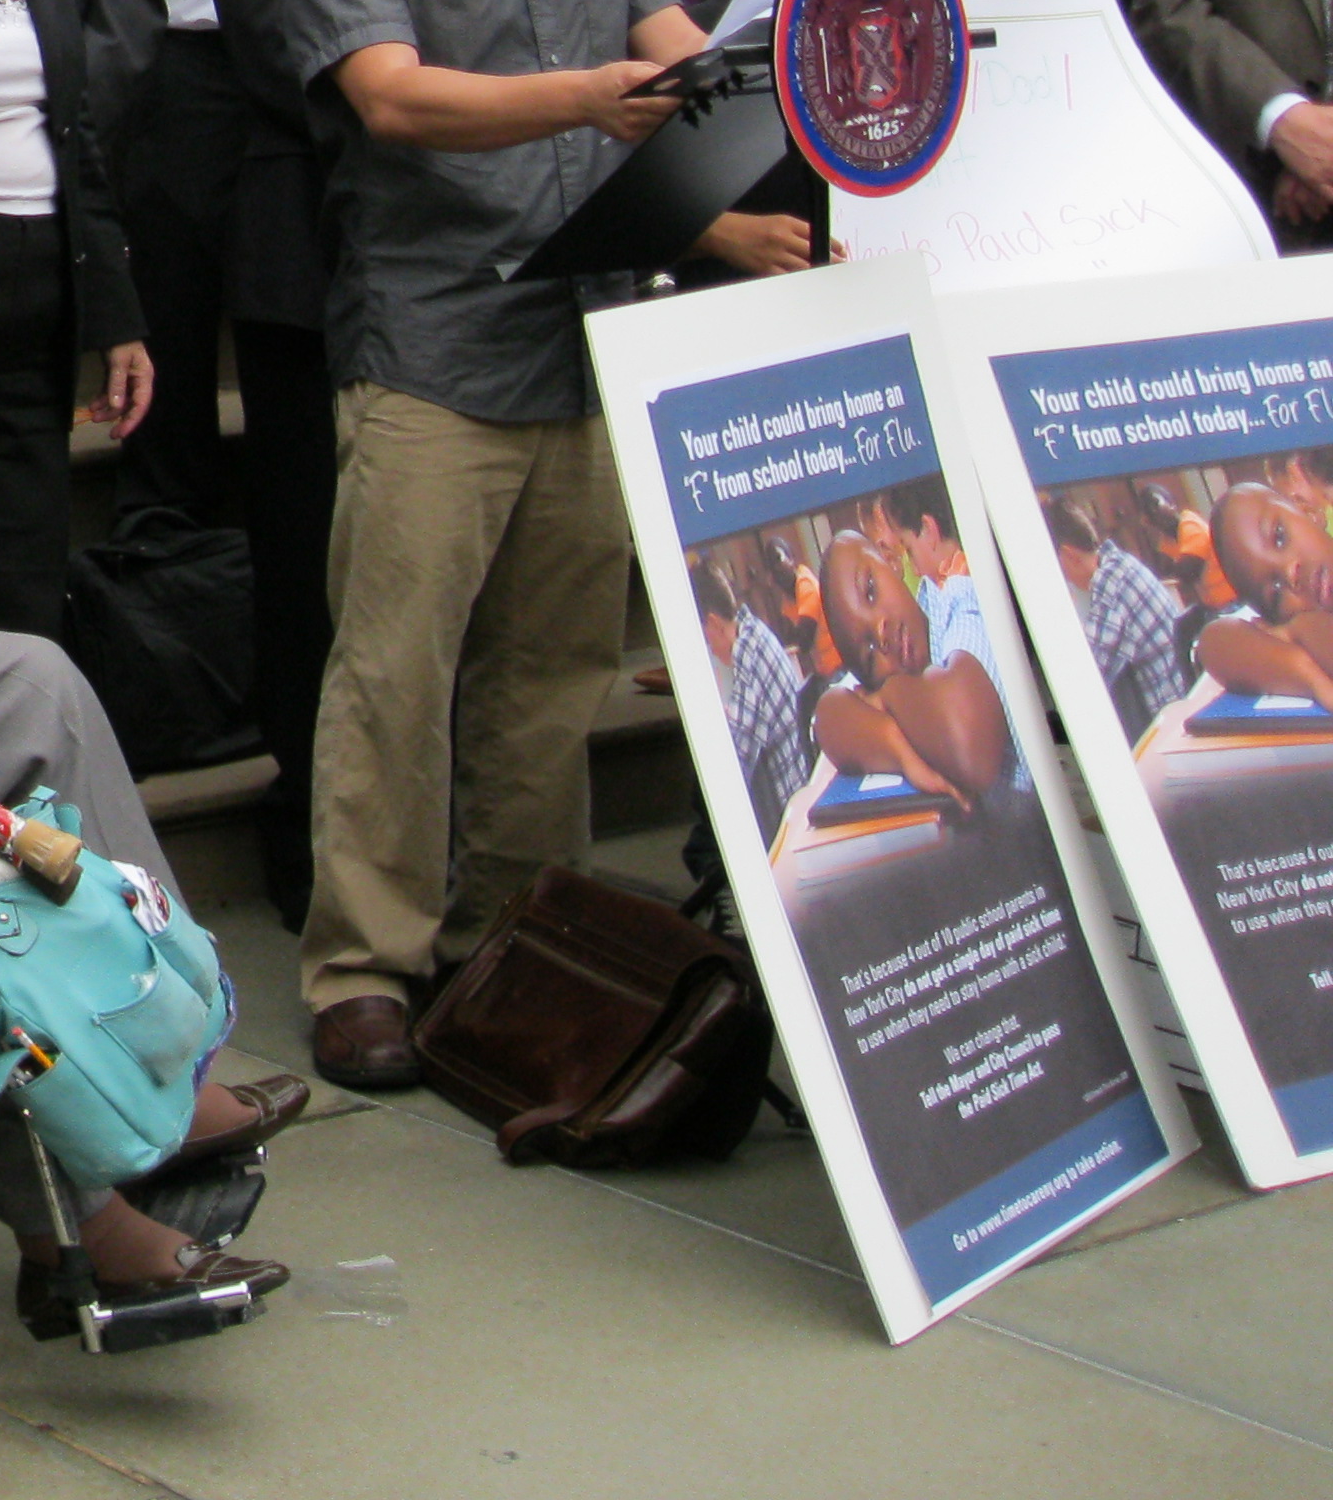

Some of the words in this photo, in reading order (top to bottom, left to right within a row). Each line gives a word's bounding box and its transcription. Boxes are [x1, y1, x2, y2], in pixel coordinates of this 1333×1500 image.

[946, 209, 1054, 265] Paid
[1059, 198, 1181, 249] Sick
[1031, 387, 1082, 415] Your
[1085, 377, 1131, 409] child
[1139, 371, 1195, 403] could
[1200, 362, 1250, 398] bring
[1250, 355, 1304, 386] home
[1309, 357, 1332, 378] an
[681, 426, 720, 462] Your
[722, 414, 760, 452] child
[762, 406, 805, 444] could
[806, 395, 843, 436] bring
[845, 390, 883, 421] home
[884, 383, 904, 408] an
[1072, 423, 1122, 452] from
[1125, 414, 1192, 445] school
[1192, 404, 1265, 436] today...
[1263, 395, 1299, 428] For
[712, 466, 752, 500] from
[754, 448, 804, 492] school
[855, 426, 881, 464] For
[1217, 861, 1255, 882] That's
[1256, 852, 1307, 874] because
[1307, 846, 1316, 862] 4
[1217, 890, 1247, 910] New
[1247, 885, 1275, 904] York
[1274, 879, 1300, 897] City
[1301, 876, 1317, 891] do
[1231, 919, 1246, 934] to
[1248, 912, 1268, 931] use
[1269, 907, 1303, 926] when
[1303, 899, 1332, 918] they
[840, 969, 871, 994] That's
[868, 953, 909, 982] because
[907, 946, 915, 962] 4
[915, 940, 932, 960] out
[931, 932, 942, 952] of
[940, 927, 954, 946] 10
[844, 1005, 867, 1026] New
[863, 993, 888, 1015] York
[885, 986, 905, 1006] City
[904, 978, 917, 997] do
[916, 971, 933, 991] not
[931, 964, 948, 987] get
[952, 947, 980, 973] single
[979, 941, 997, 959] day
[995, 932, 1005, 951] of
[857, 1038, 869, 1054] to
[867, 1030, 885, 1048] use
[883, 1017, 911, 1039] when
[908, 1006, 930, 1027] they
[928, 991, 952, 1016] need
[949, 991, 961, 1005] to
[960, 981, 980, 1001] stay
[943, 1045, 961, 1064] We
[959, 1039, 977, 1057] can
[974, 1024, 1004, 1049] change
[919, 1086, 939, 1108] Tell
[935, 1083, 952, 1100] the
[948, 1070, 977, 1093] Mayor
[975, 1057, 993, 1079] and
[989, 1052, 1008, 1070] City
[958, 1101, 974, 1119] the
[972, 1087, 993, 1111] Paid
[952, 1233, 968, 1252] Go
[966, 1229, 979, 1243] to
